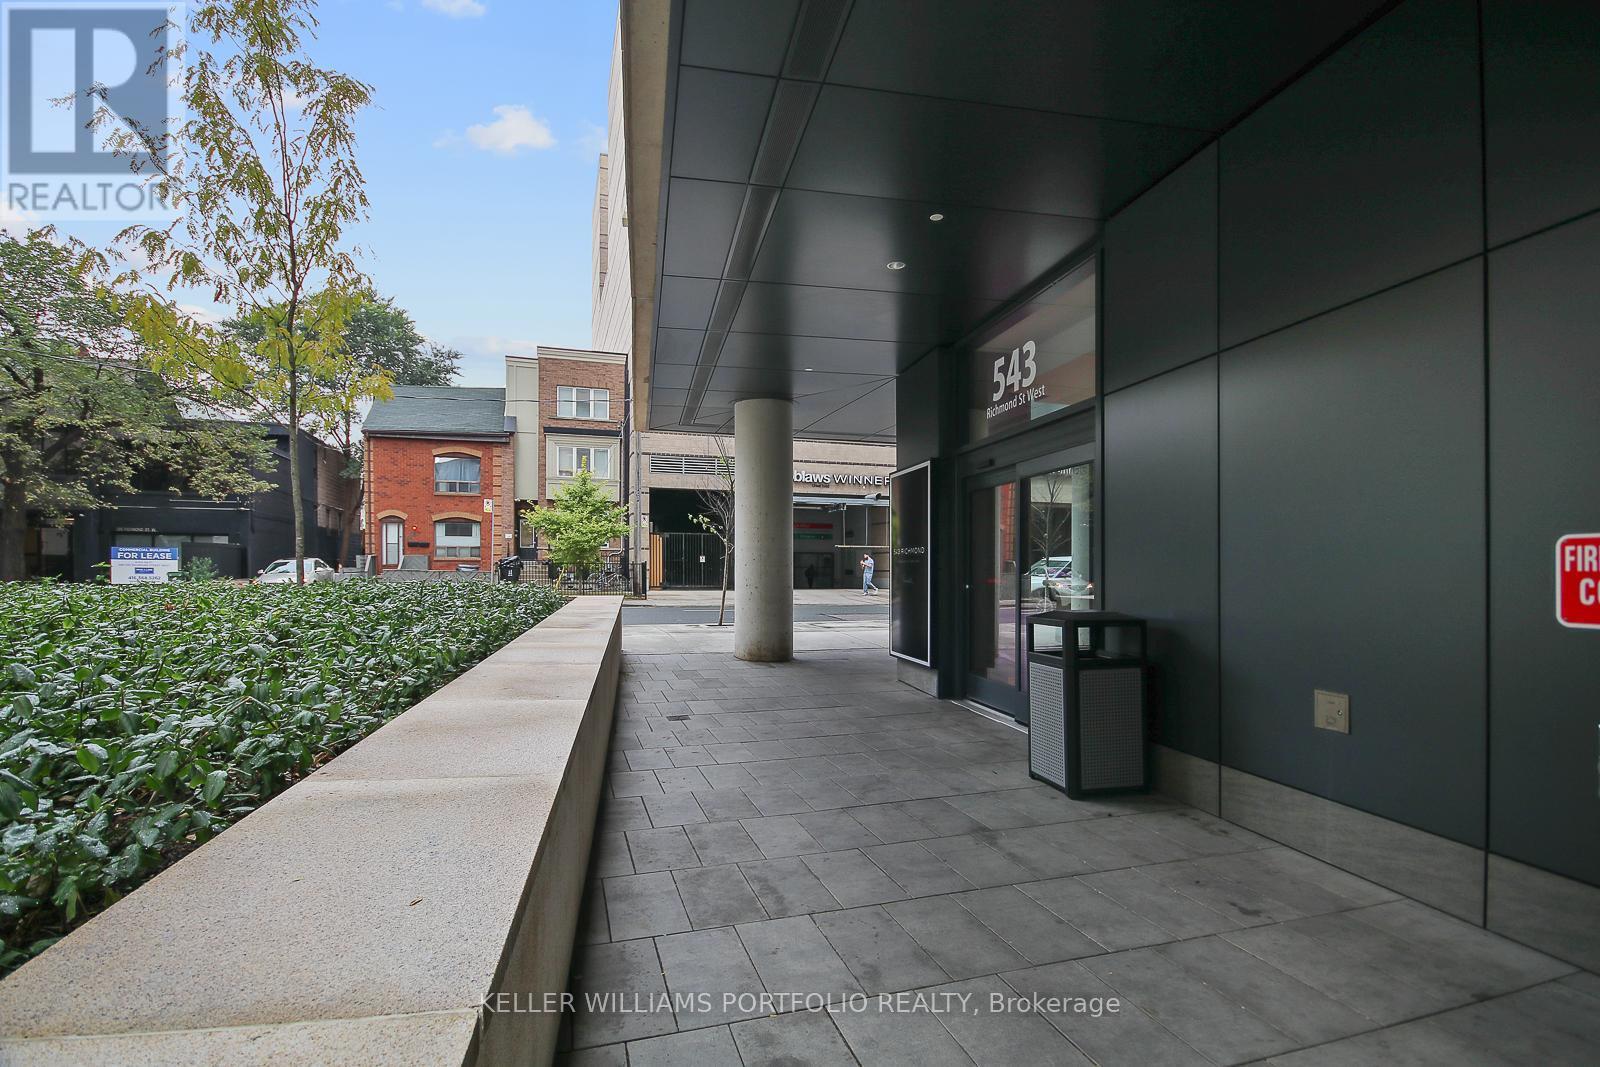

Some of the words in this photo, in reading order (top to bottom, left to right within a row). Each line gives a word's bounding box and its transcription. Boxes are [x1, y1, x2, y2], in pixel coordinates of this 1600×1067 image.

[992, 340, 1037, 402] 543
[986, 395, 1018, 419] Richmond
[1018, 392, 1026, 406] St
[1027, 384, 1045, 402] West
[793, 469, 831, 483] blaws
[141, 552, 172, 560] LEASE
[1564, 544, 1600, 572] FIR
[1580, 577, 1600, 606] C
